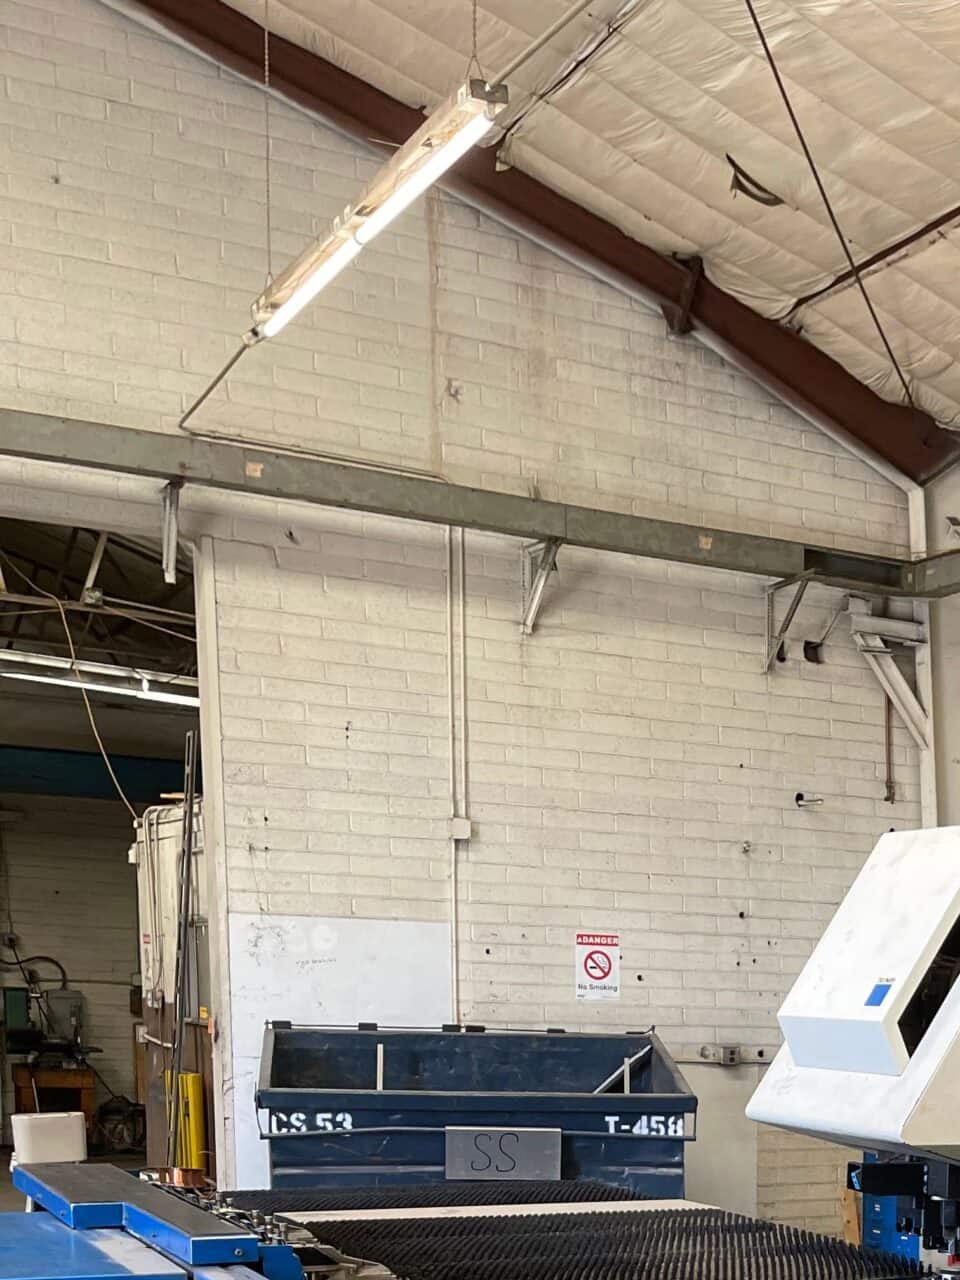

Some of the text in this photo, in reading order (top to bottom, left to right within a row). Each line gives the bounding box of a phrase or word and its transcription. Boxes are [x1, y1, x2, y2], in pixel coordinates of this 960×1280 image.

[583, 936, 618, 945] DANGER
[589, 984, 618, 992] Smoking
[271, 1112, 353, 1136] CS 53
[604, 1115, 684, 1136] T-458
[471, 1133, 519, 1172] SS
